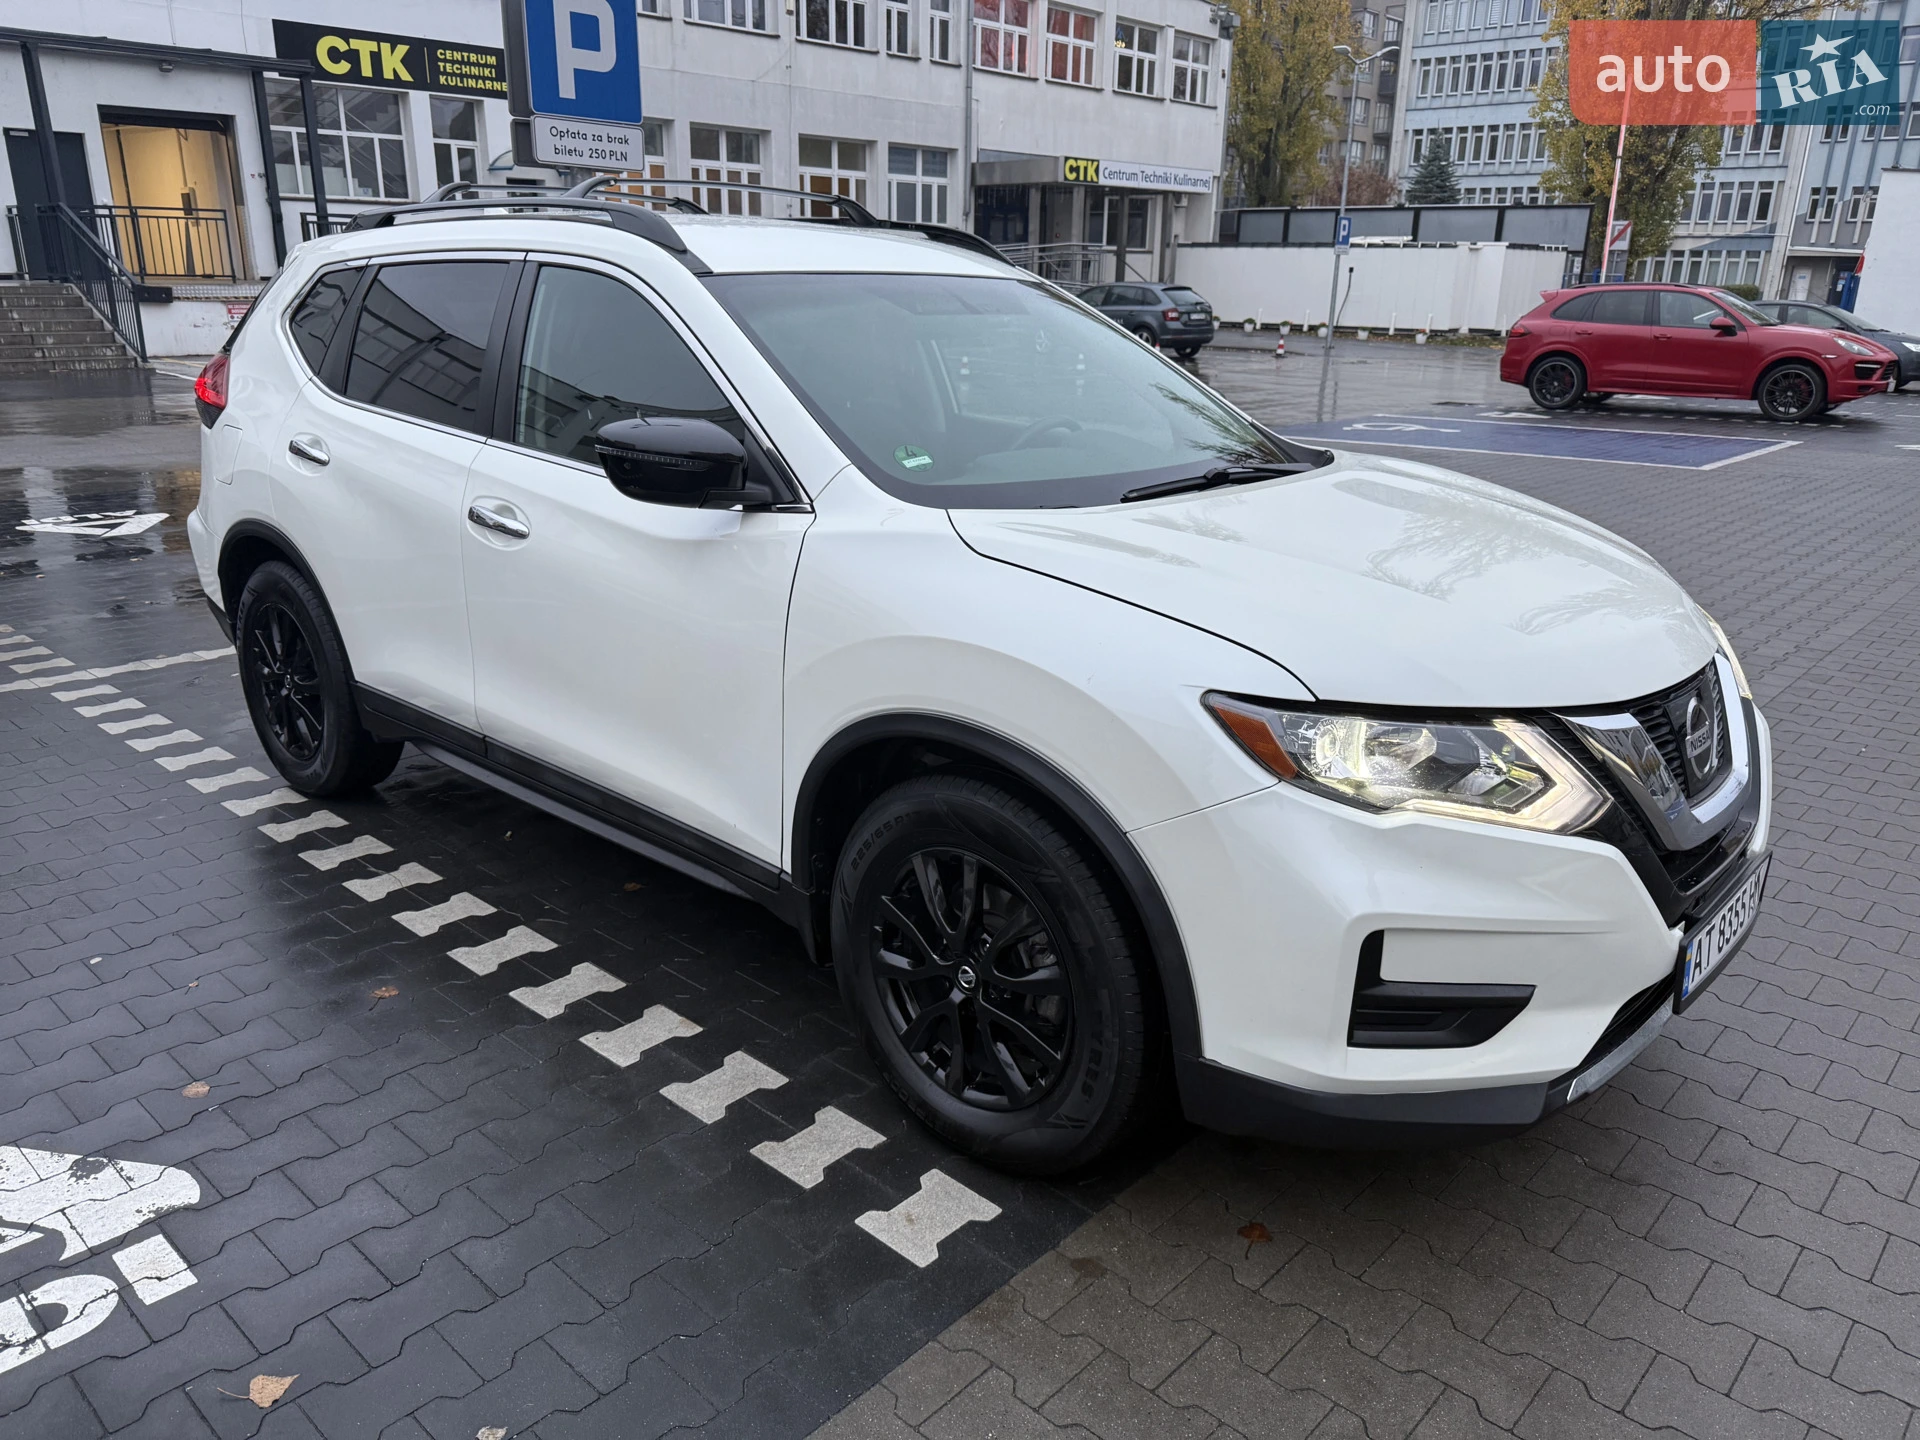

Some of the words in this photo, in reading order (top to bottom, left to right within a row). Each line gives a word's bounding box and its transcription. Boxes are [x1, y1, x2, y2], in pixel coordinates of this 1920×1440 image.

[316, 35, 414, 82] CTK
[436, 49, 497, 66] CENTRUM
[553, 0, 617, 100] P
[438, 62, 496, 78] TECHNIKI
[439, 75, 508, 92] KULINARNE
[549, 125, 587, 141] Opłata
[591, 132, 603, 143] za
[607, 133, 630, 146] brak
[554, 145, 584, 158] biletu
[588, 148, 607, 160] 250
[609, 150, 628, 162] PLN
[1065, 158, 1098, 182] CTK
[1103, 167, 1138, 182] Centrum
[1140, 169, 1172, 184] Techniki
[1173, 174, 1211, 190] Kulinarnej
[1339, 219, 1349, 242] P
[1690, 729, 1711, 752] NISSA
[1691, 923, 1716, 984] AT
[1717, 887, 1748, 954] 8355
